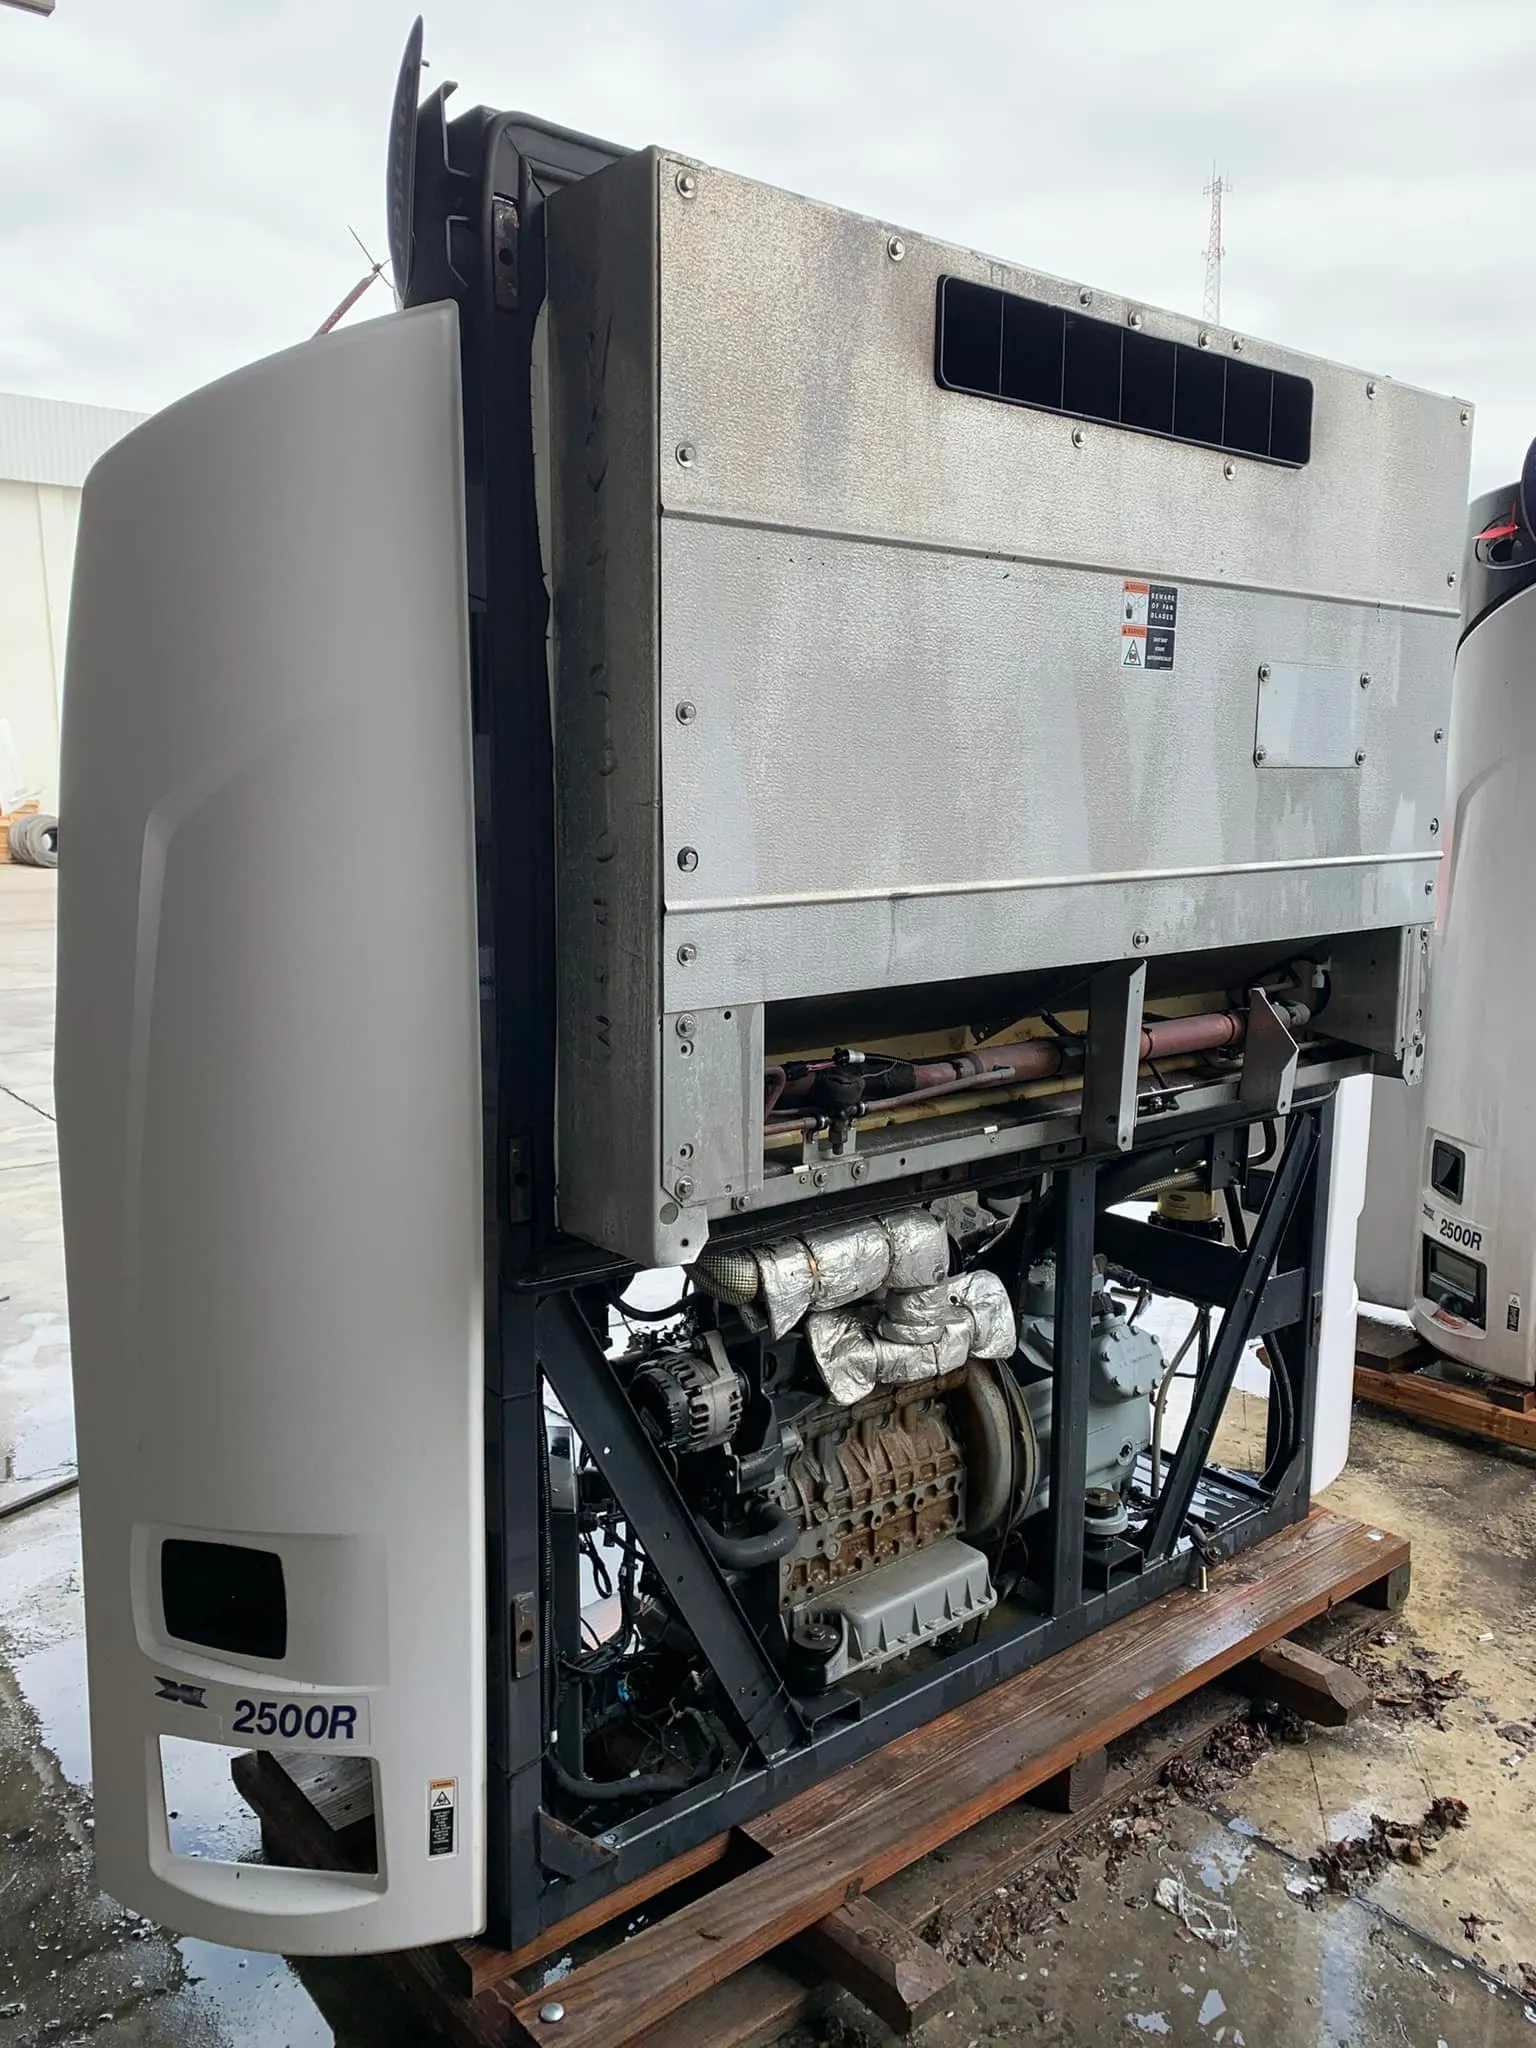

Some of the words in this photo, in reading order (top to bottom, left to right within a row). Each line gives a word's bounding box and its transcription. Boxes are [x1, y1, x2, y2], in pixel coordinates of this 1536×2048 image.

[1151, 592, 1175, 602] BEWARE
[1162, 603, 1174, 611] FAN
[1150, 612, 1173, 621] BLADES
[1439, 1218, 1483, 1251] 2500R
[232, 1699, 358, 1740] 2500R
